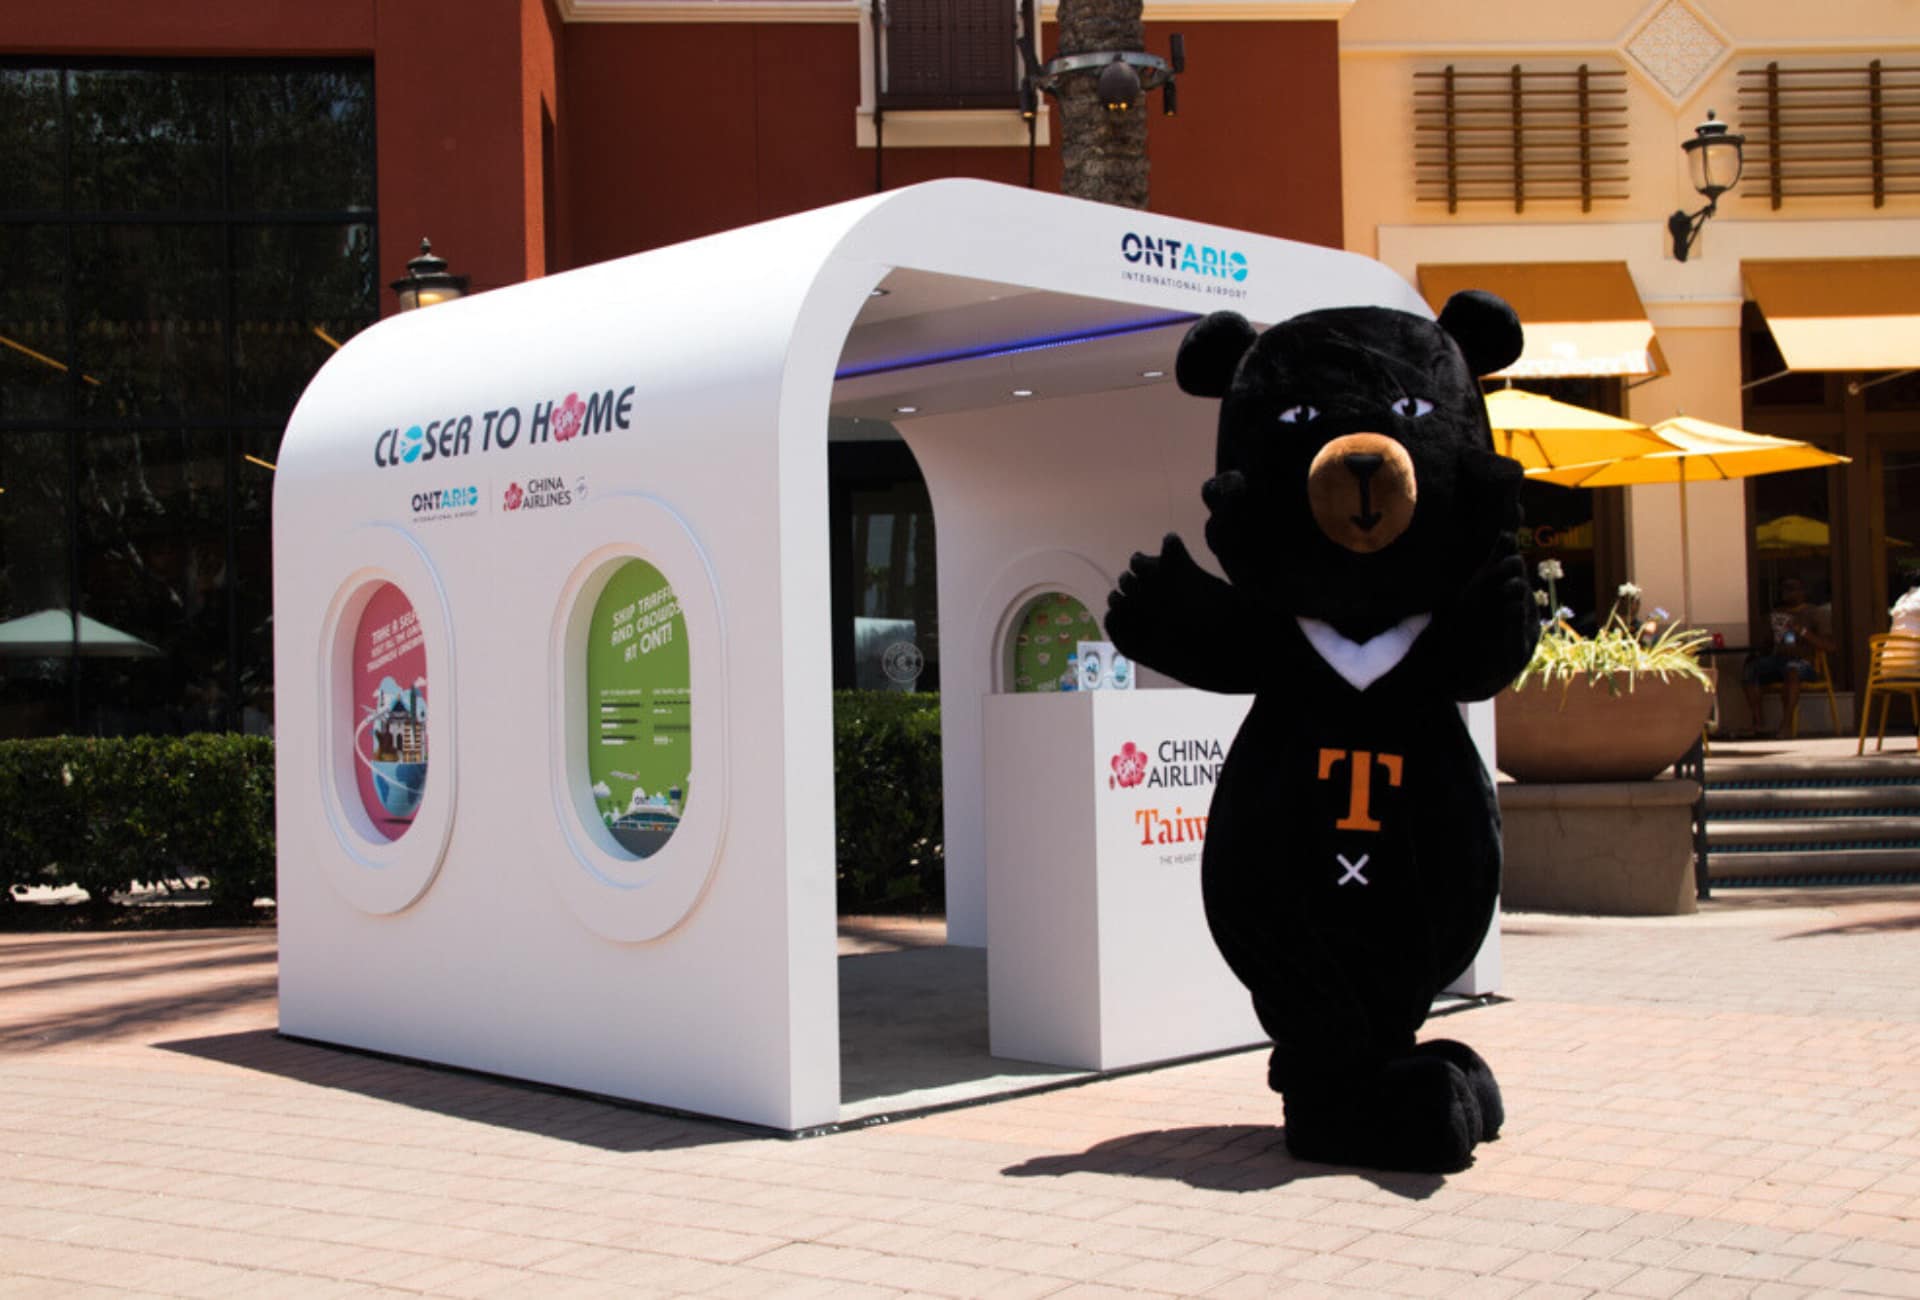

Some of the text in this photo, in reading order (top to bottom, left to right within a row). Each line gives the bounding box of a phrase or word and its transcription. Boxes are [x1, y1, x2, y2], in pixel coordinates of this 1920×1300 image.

[1121, 232, 1248, 282] ONTARIO
[1121, 270, 1248, 300] INTERNATIONAL AIRPORT
[374, 386, 635, 468] CLOSER TO HOME
[411, 485, 478, 513] ONTARIO
[528, 476, 565, 494] CHINA
[522, 490, 572, 512] AIRLINES
[640, 621, 672, 654] ONT!
[1158, 739, 1224, 763] CHINA
[1318, 748, 1403, 832] T
